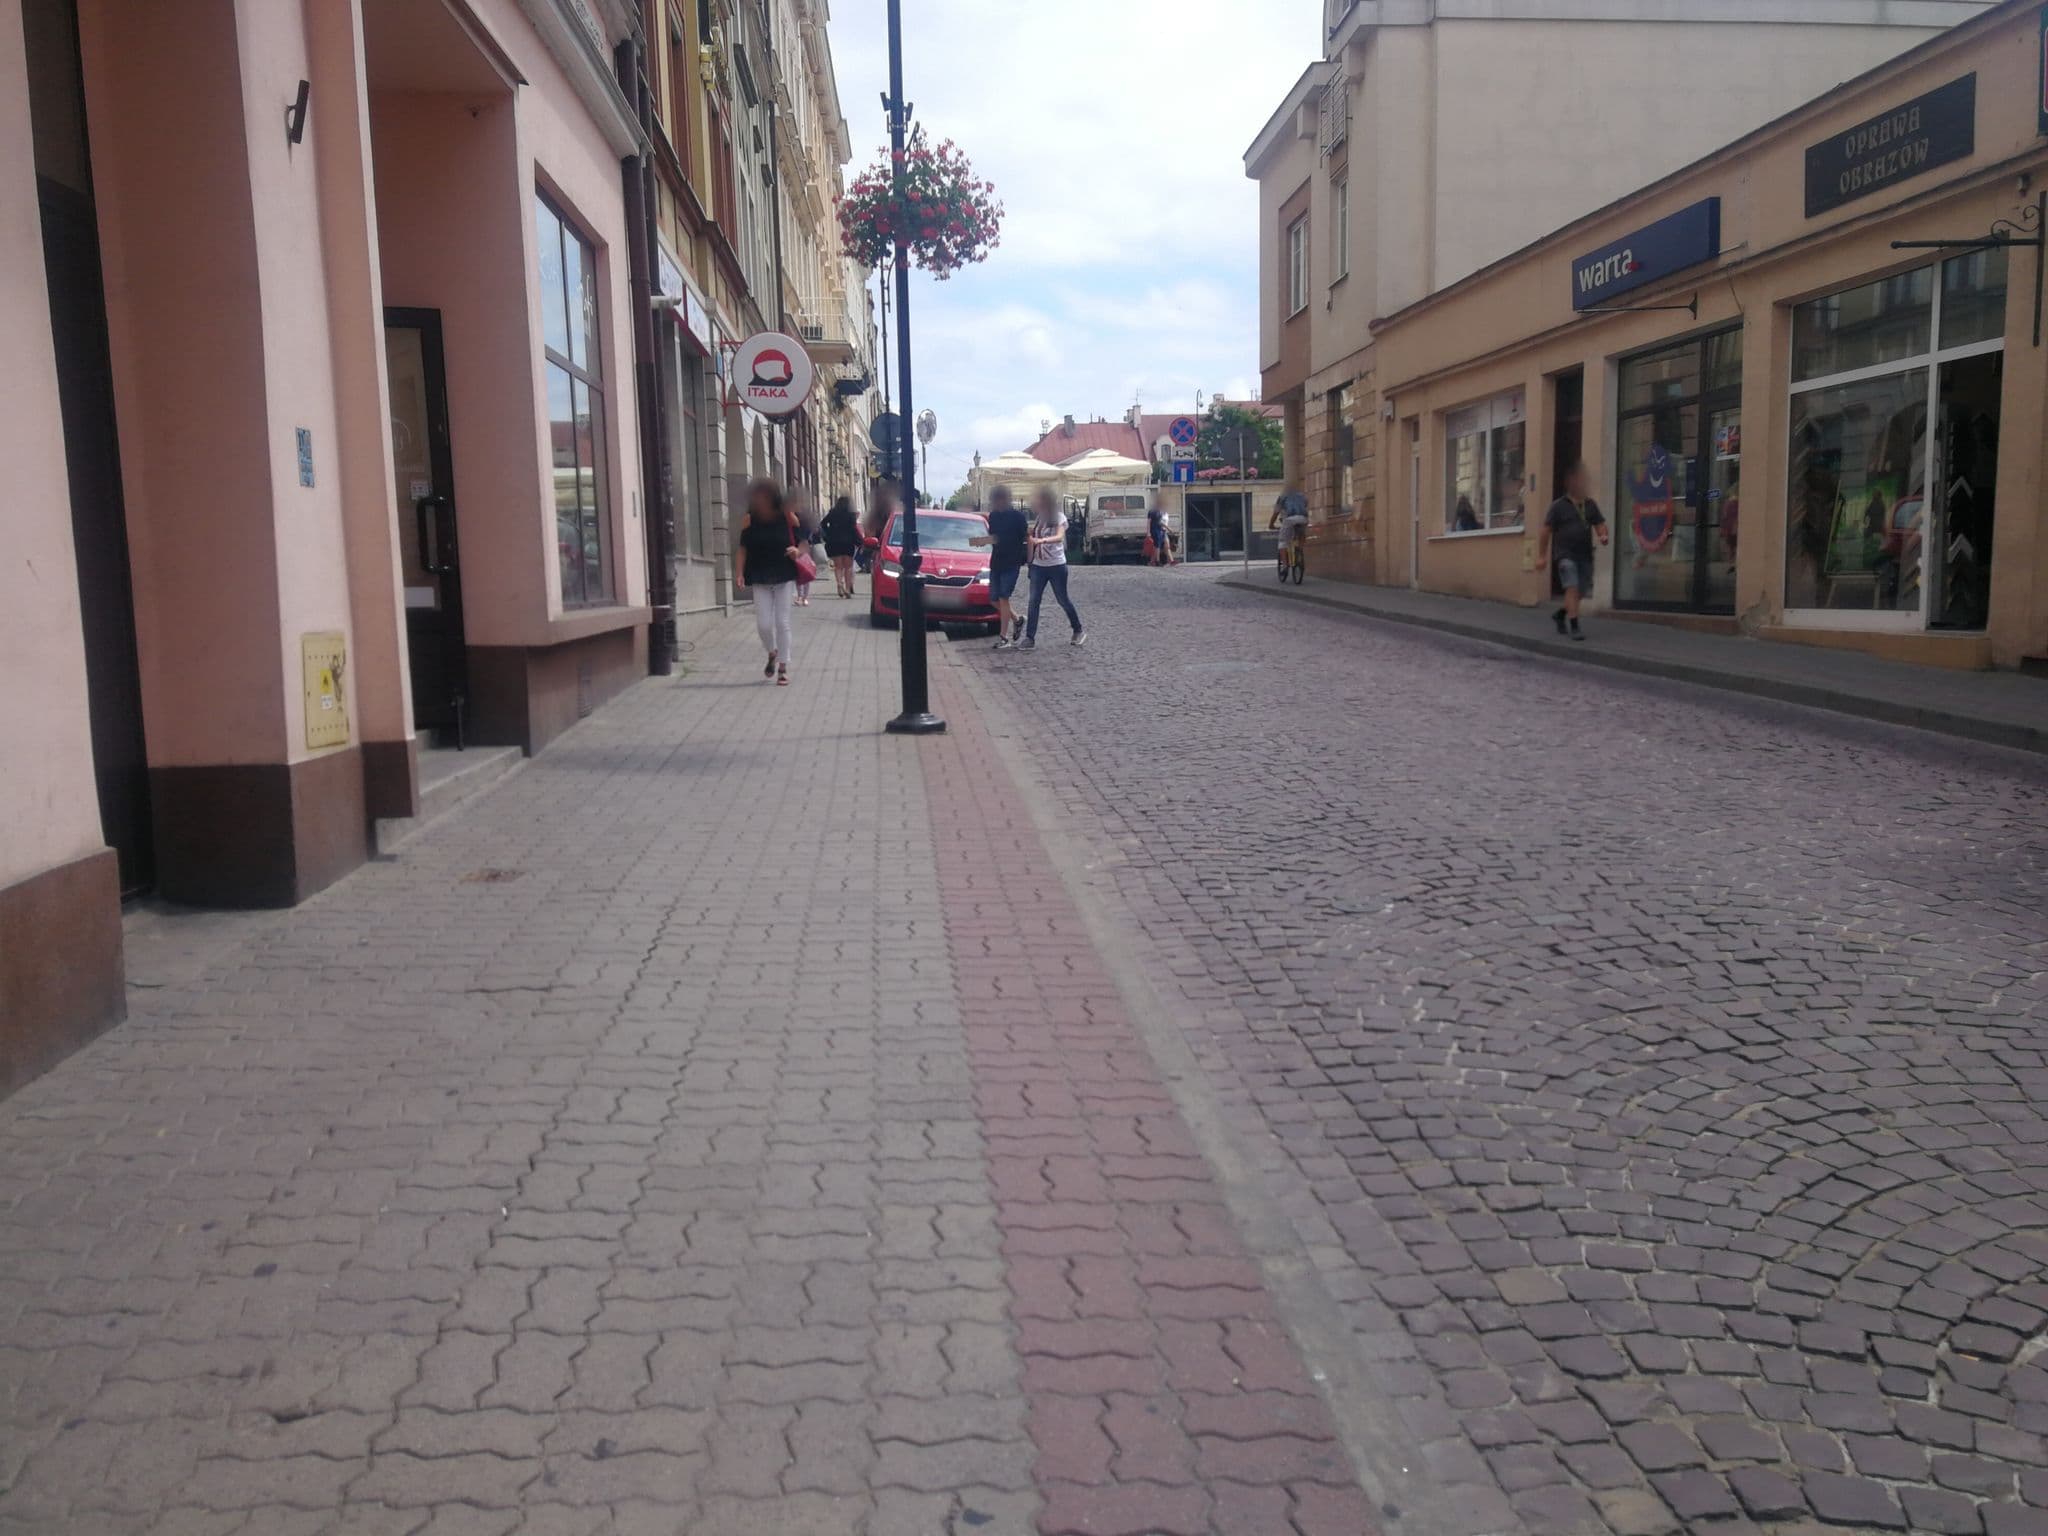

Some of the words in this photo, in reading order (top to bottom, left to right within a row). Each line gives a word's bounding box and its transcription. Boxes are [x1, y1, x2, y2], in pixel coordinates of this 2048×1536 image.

[1844, 106, 1921, 159] OPRAWA
[1578, 248, 1634, 293] warta
[747, 387, 789, 398] ITAKA
